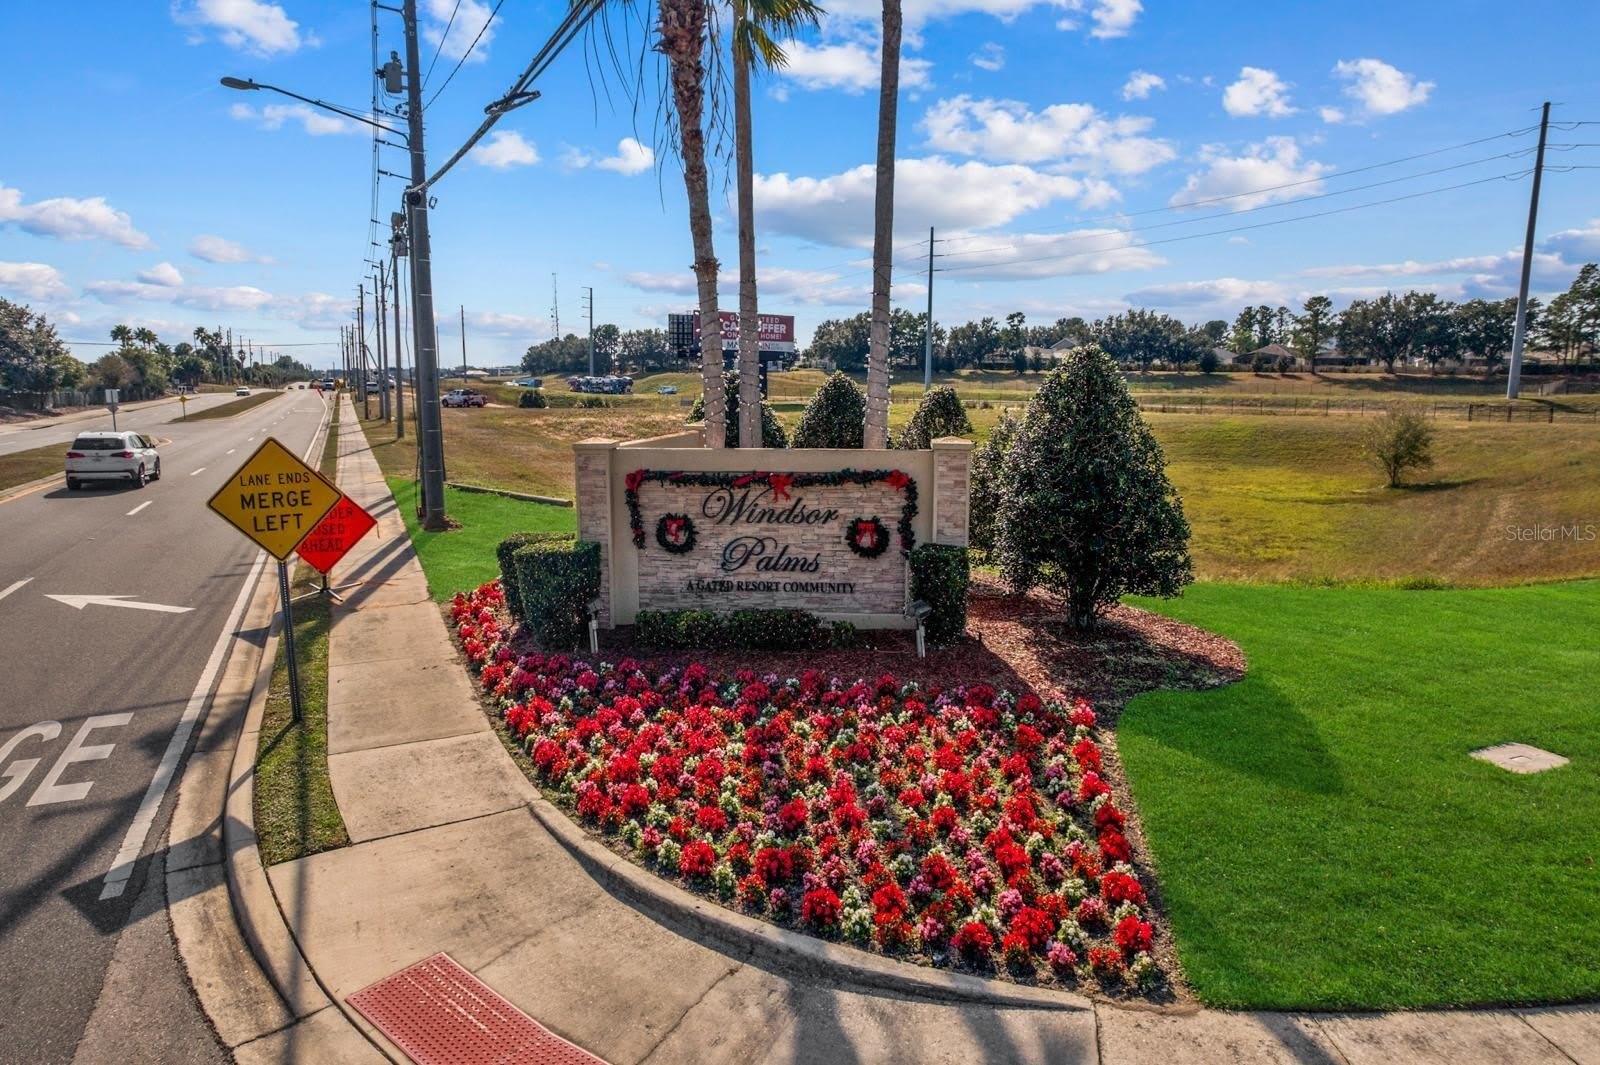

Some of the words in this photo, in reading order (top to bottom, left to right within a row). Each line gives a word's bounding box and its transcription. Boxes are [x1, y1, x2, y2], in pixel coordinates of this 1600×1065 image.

[759, 324, 787, 334] FFER
[240, 473, 271, 487] LANE
[278, 472, 311, 485] ENDS
[240, 490, 312, 510] MERGE
[702, 486, 839, 526] Windsor
[253, 513, 303, 532] LEFT
[301, 538, 343, 553] AHEAD
[721, 536, 821, 573] Palms
[686, 581, 694, 591] A
[737, 581, 781, 592] RESORT
[783, 582, 856, 594] COMMUNITY
